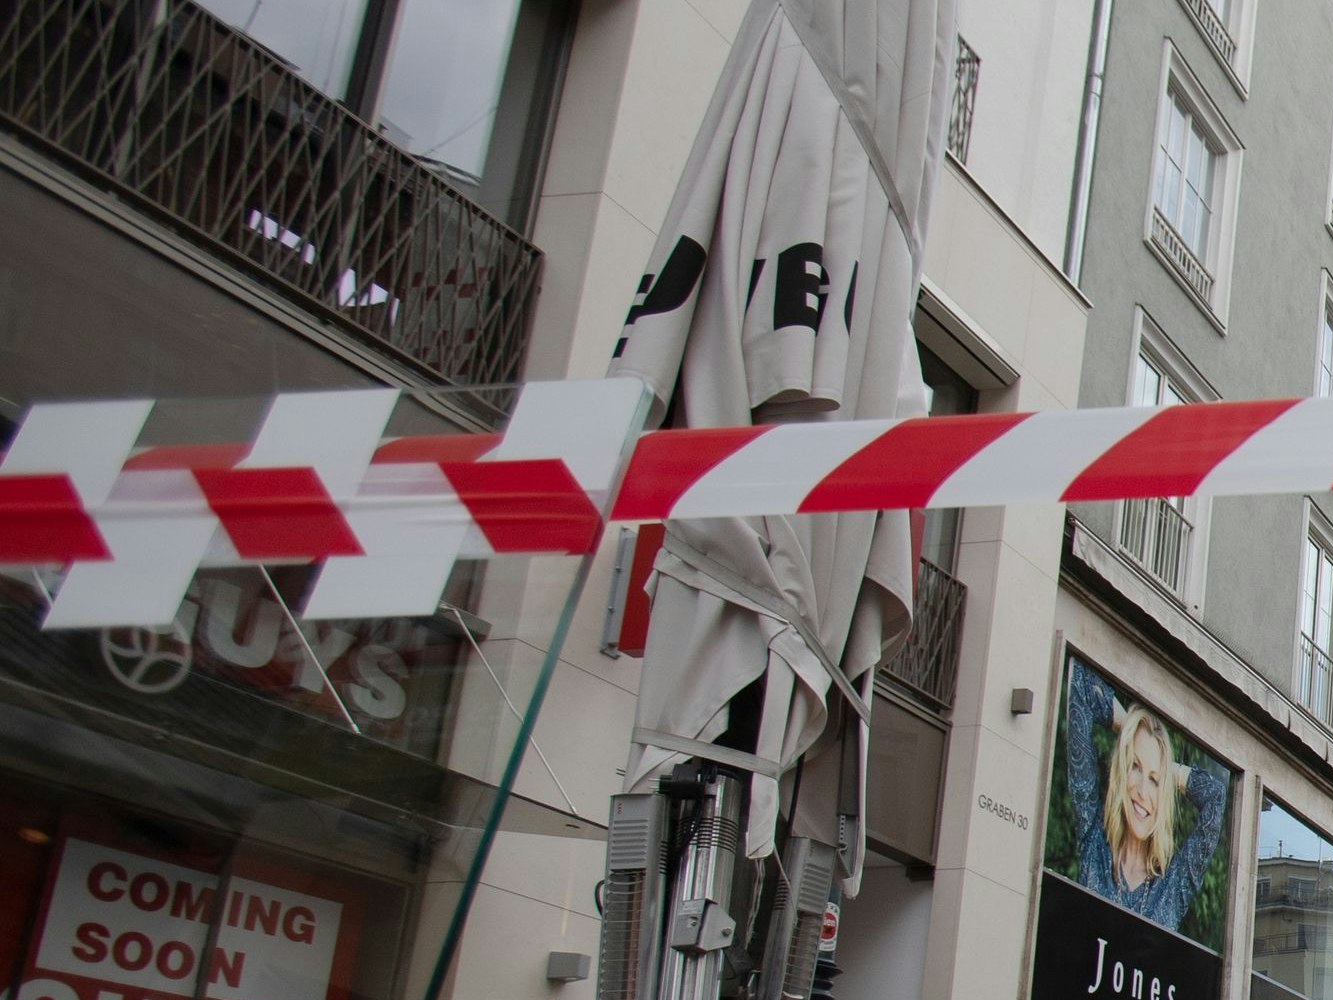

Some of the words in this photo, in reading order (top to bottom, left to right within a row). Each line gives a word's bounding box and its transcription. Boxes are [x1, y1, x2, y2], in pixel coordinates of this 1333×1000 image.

[185, 575, 408, 720] UYS
[978, 794, 1016, 824] GRABEN
[1017, 814, 1029, 831] 30
[87, 861, 316, 945] COMING
[72, 922, 246, 988] SOON
